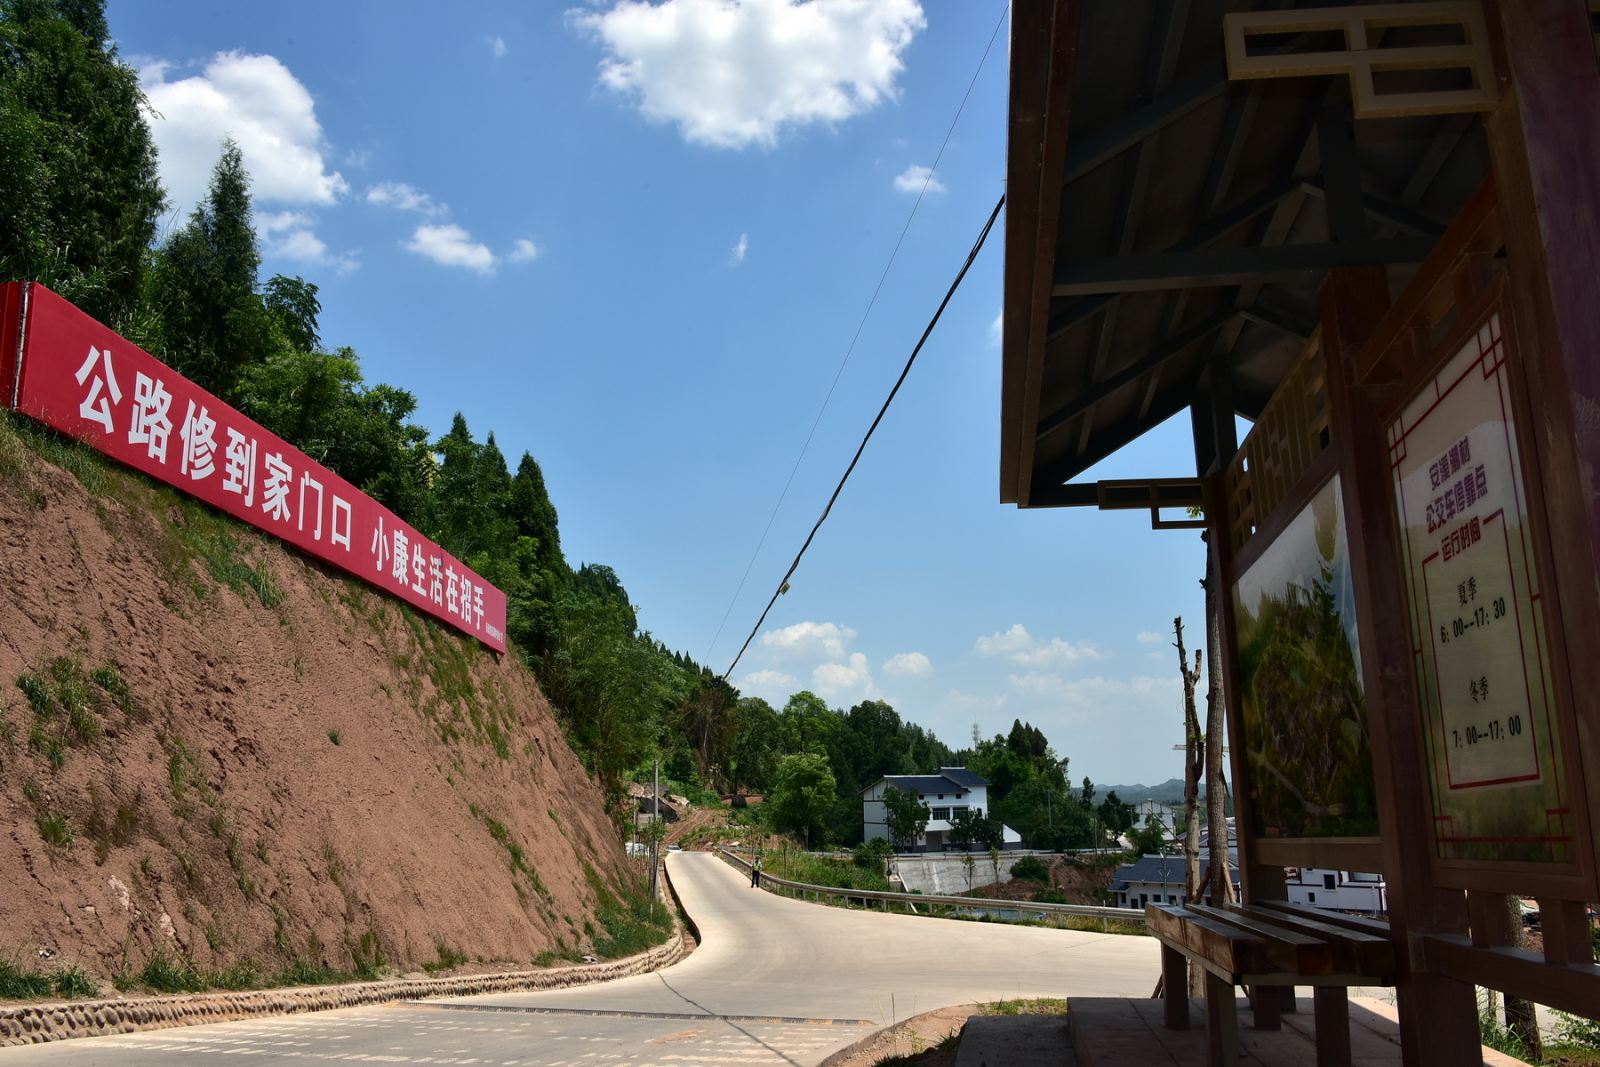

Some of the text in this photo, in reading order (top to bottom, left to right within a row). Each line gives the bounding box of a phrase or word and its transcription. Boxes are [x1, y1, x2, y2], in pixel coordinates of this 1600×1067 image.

[75, 344, 485, 630] 公路修到家门口 小康生活在招手
[1426, 464, 1488, 534] 公交车停靠点
[1441, 516, 1481, 562] 运行时间
[1456, 576, 1478, 606] 夏季
[1469, 676, 1489, 703] 冬季
